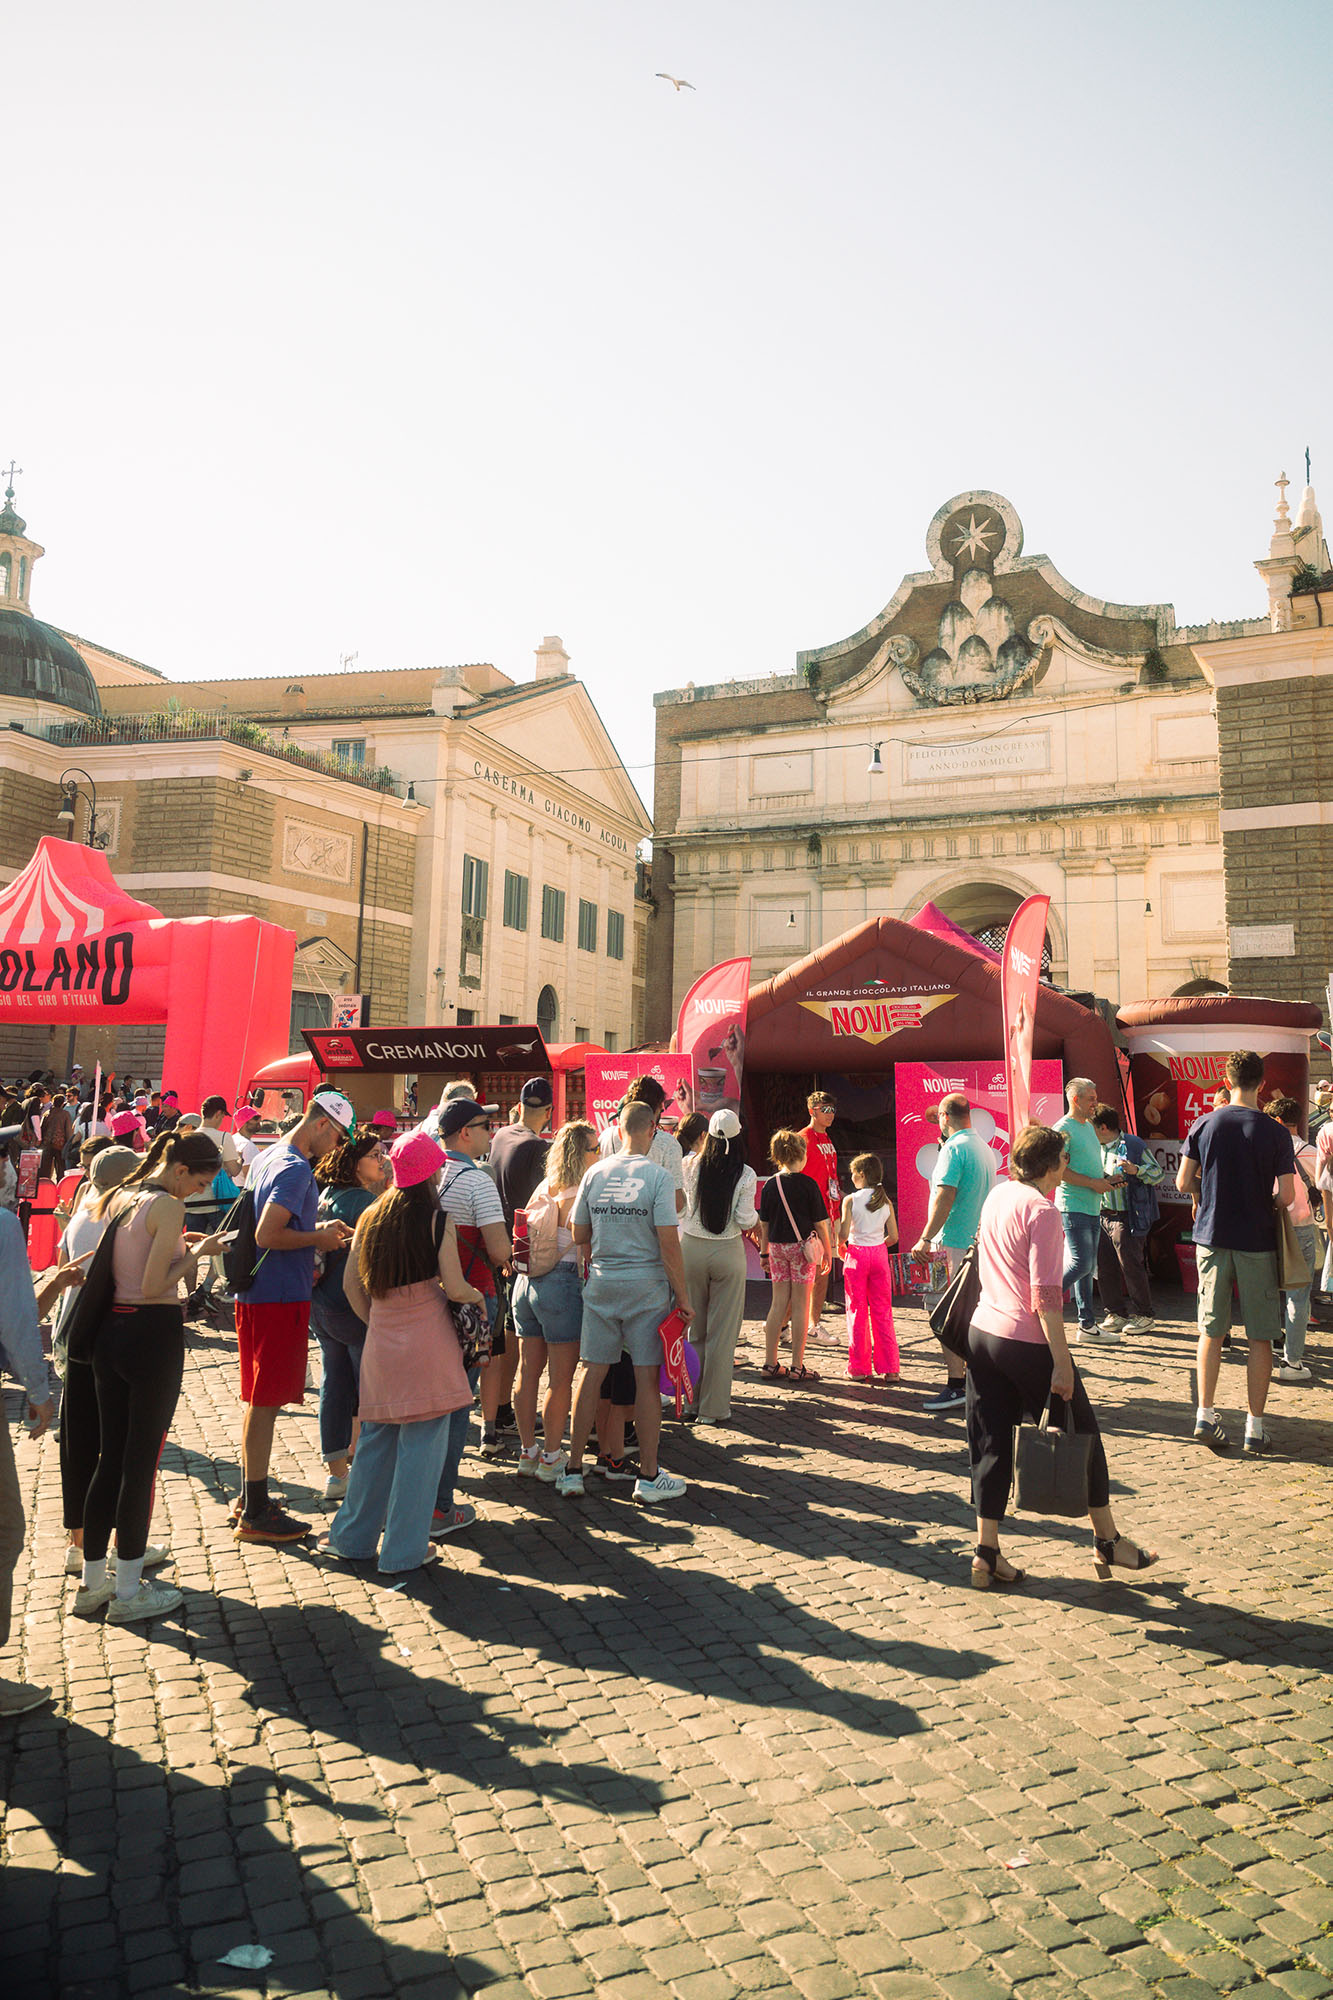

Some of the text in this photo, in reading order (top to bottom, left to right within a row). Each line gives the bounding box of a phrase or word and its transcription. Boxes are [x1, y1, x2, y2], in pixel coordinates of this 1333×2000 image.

[474, 761, 628, 853] CASERMA GIACOMO ACQUA
[853, 986, 908, 995] CIOCCOLATO
[909, 984, 951, 992] ITALIANO
[16, 994, 33, 1006] DEL
[37, 994, 58, 1006] GIRO
[62, 993, 99, 1006] D'ITALIA
[694, 999, 726, 1014] NOVI
[830, 1004, 892, 1036] NOVI
[601, 1070, 620, 1081] NOVI
[1166, 1056, 1219, 1081] NOVI
[922, 1078, 951, 1093] NOVI
[591, 1205, 649, 1217] new balance
